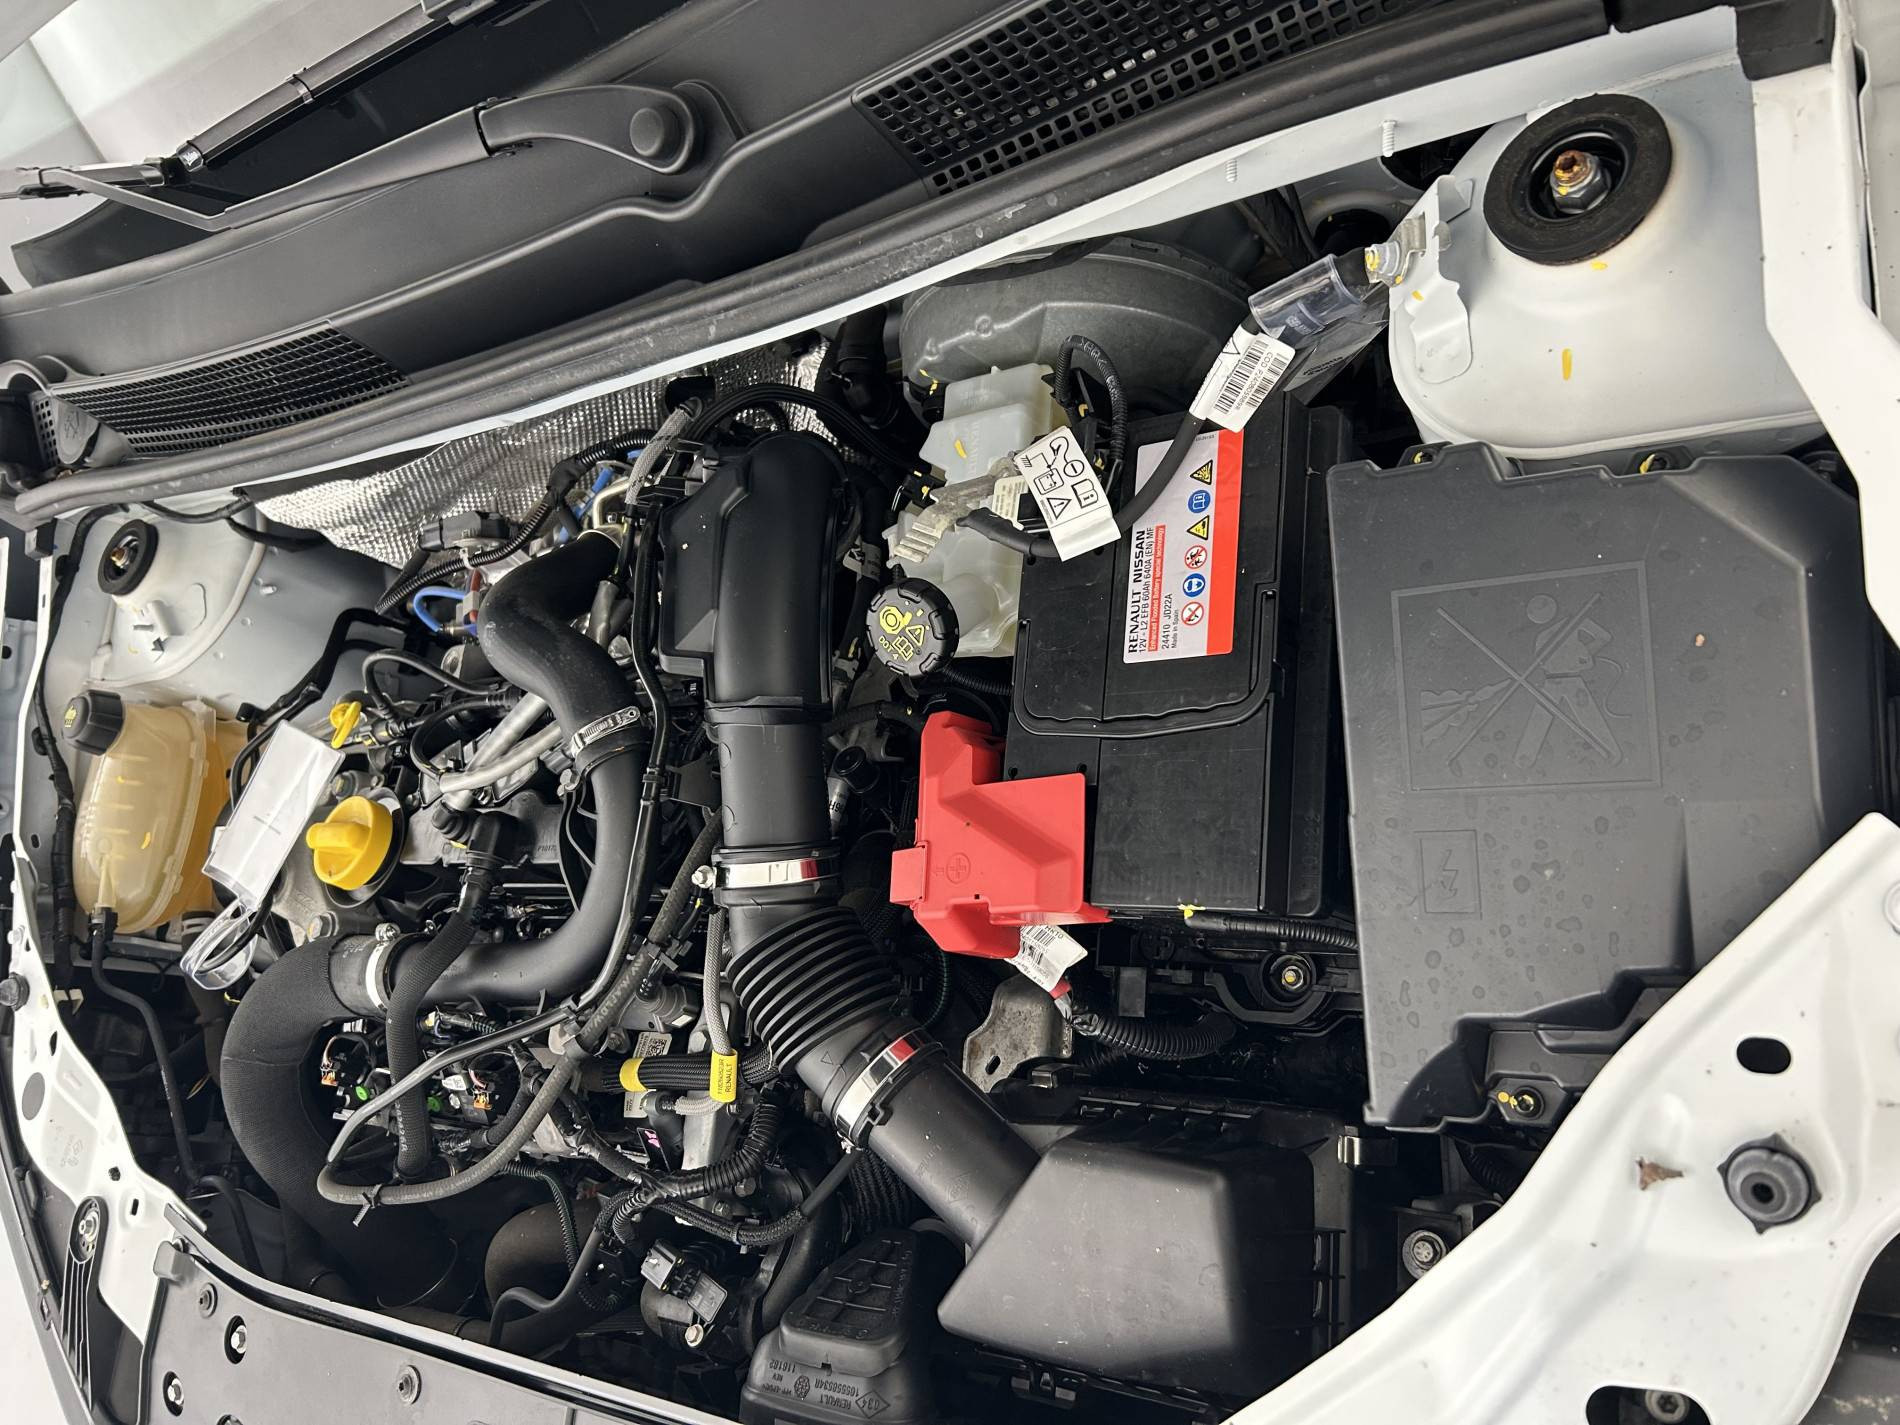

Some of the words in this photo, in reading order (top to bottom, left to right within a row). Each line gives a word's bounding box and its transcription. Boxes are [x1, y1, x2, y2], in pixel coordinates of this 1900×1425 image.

[1146, 527, 1153, 538] MF
[1154, 527, 1164, 557] technology
[1133, 530, 1145, 583] NISSAN
[1145, 540, 1154, 556] (EN)
[1143, 558, 1152, 578] 640A
[1153, 558, 1162, 577] special
[1141, 580, 1150, 601] 60Ah
[1151, 578, 1161, 598] Battery
[1141, 603, 1149, 617] EFB
[1150, 599, 1159, 621] Flooded
[1163, 593, 1173, 619] JD22A
[1128, 589, 1141, 652] RENAULT
[1140, 620, 1147, 630] L2
[1172, 609, 1180, 624] Spain
[879, 635, 894, 653] DOT
[1138, 638, 1146, 652] 12V
[1148, 622, 1157, 649] Enhanced
[1161, 623, 1170, 648] 24410
[725, 1063, 733, 1093] RENAULT
[819, 1393, 852, 1410] RENAULT
